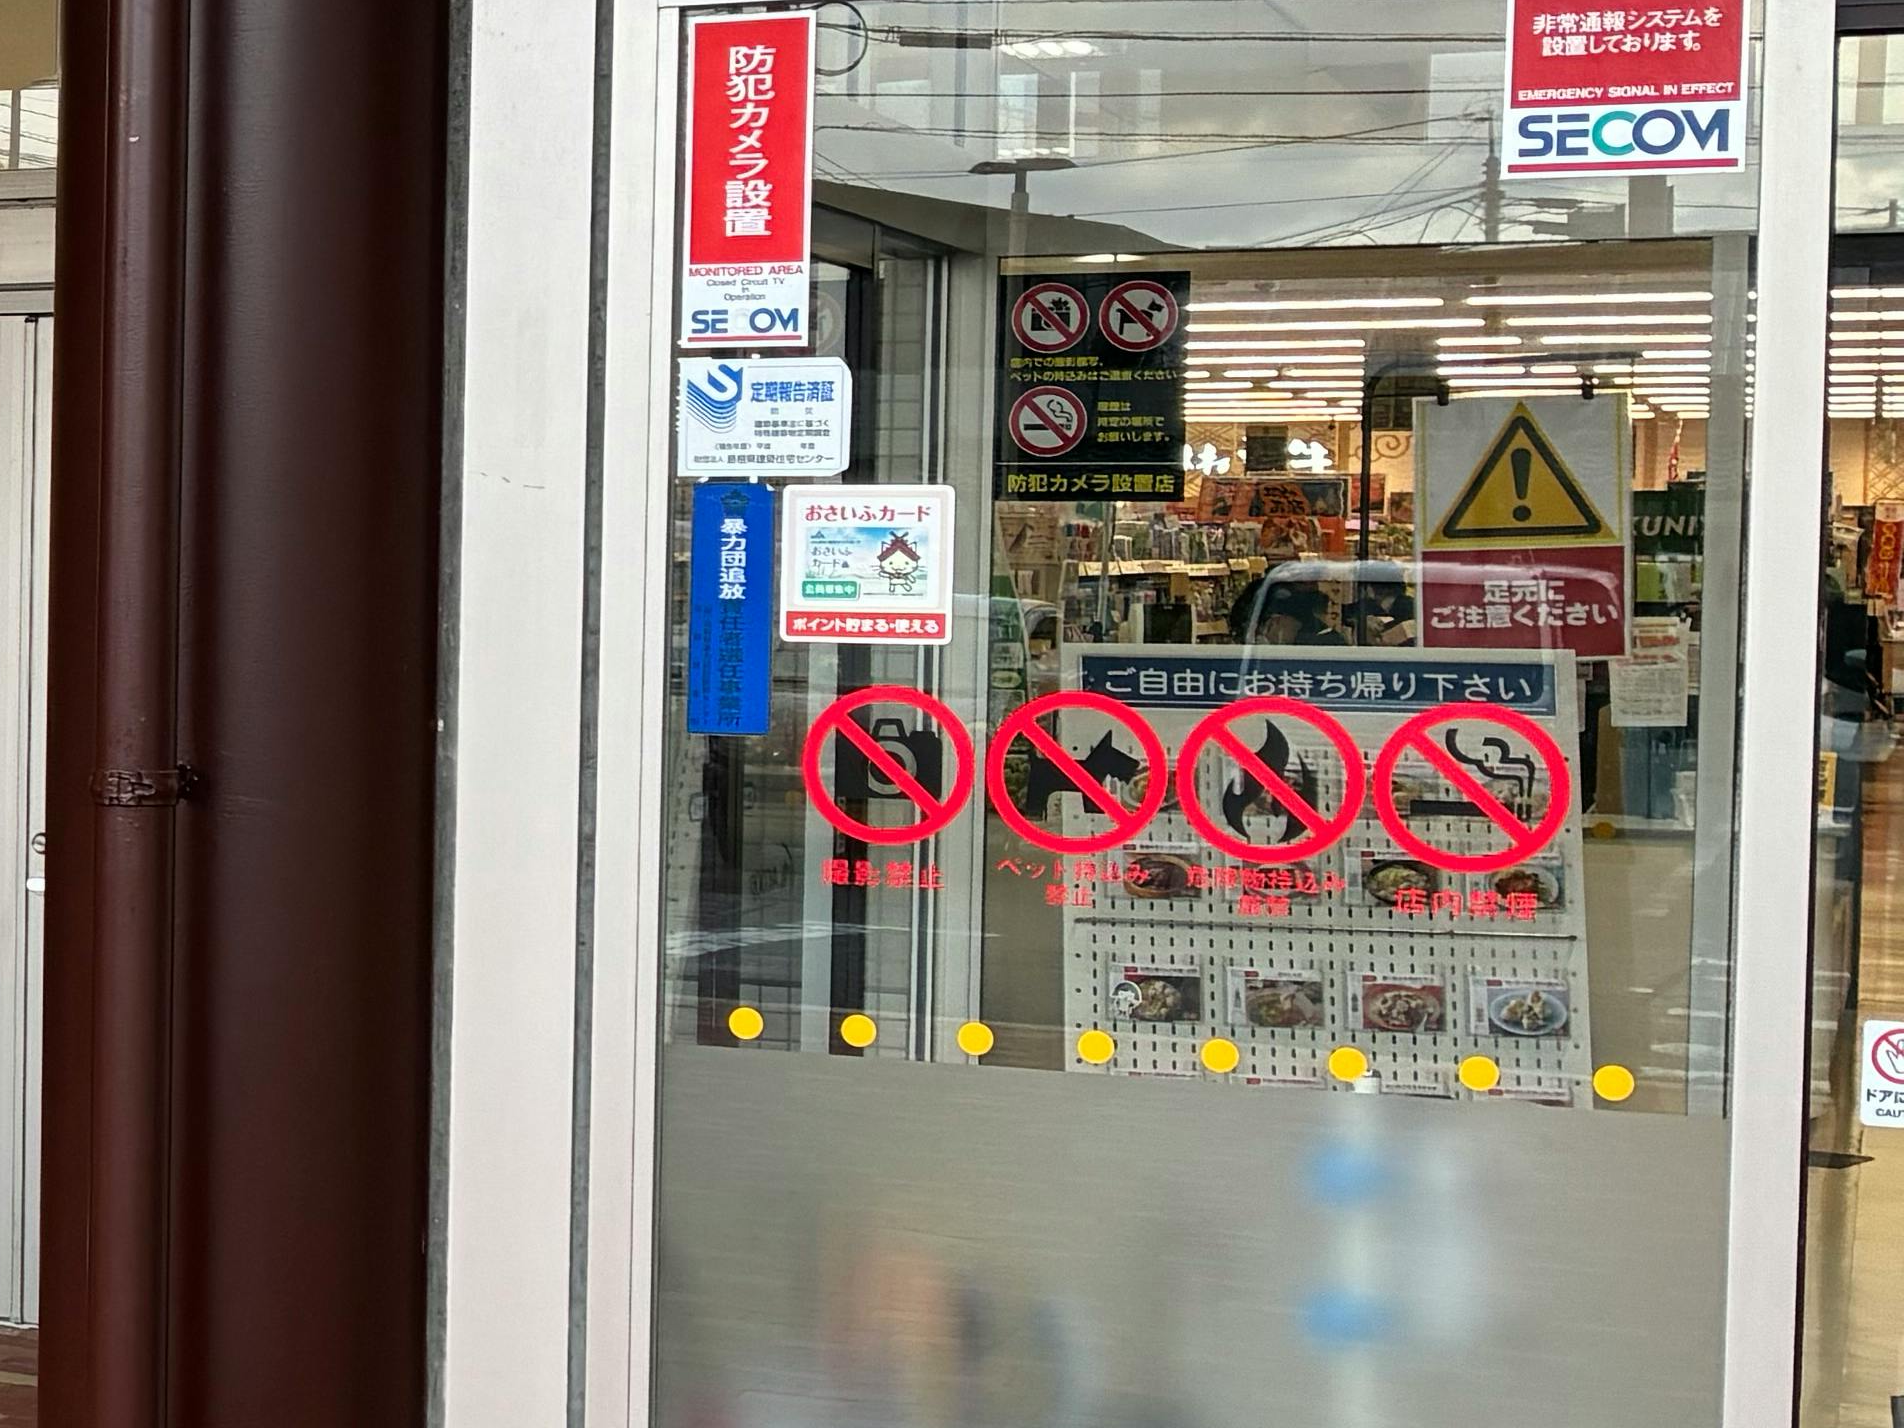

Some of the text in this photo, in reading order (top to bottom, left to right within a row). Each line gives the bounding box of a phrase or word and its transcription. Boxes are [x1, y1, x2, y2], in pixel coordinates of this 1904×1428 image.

[1533, 7, 1723, 35] 非常通報システムを
[1542, 31, 1701, 56] 設置しております。
[1518, 82, 1734, 101] EMERGENCY SIGNAL IN EFFECT
[723, 45, 777, 238] 防犯カメラ設置
[1518, 108, 1730, 157] SECOM
[688, 264, 803, 277] MONITORED AREA
[706, 278, 737, 287] Closed
[772, 277, 785, 285] TV
[723, 292, 766, 301] Operation
[691, 308, 799, 334] SEOM
[750, 380, 835, 402] 定期報告済証
[1008, 474, 1174, 493] 防犯カメラ設置店
[804, 505, 932, 522] おさいふカード
[811, 547, 853, 556] おさいふ
[812, 559, 841, 568] カード
[1483, 579, 1565, 602] 足元に
[793, 617, 939, 634] ポイント貯まる・使える
[1430, 603, 1619, 630] ご注意ください
[1105, 667, 1533, 703] ご自由にお持ち帰り下さい
[820, 859, 944, 889] 撮影禁止
[997, 858, 1150, 885] ペット持込み
[1185, 866, 1346, 894] 危険物持込み
[1044, 884, 1092, 907] 禁止
[1393, 887, 1538, 920] 店内禁煙
